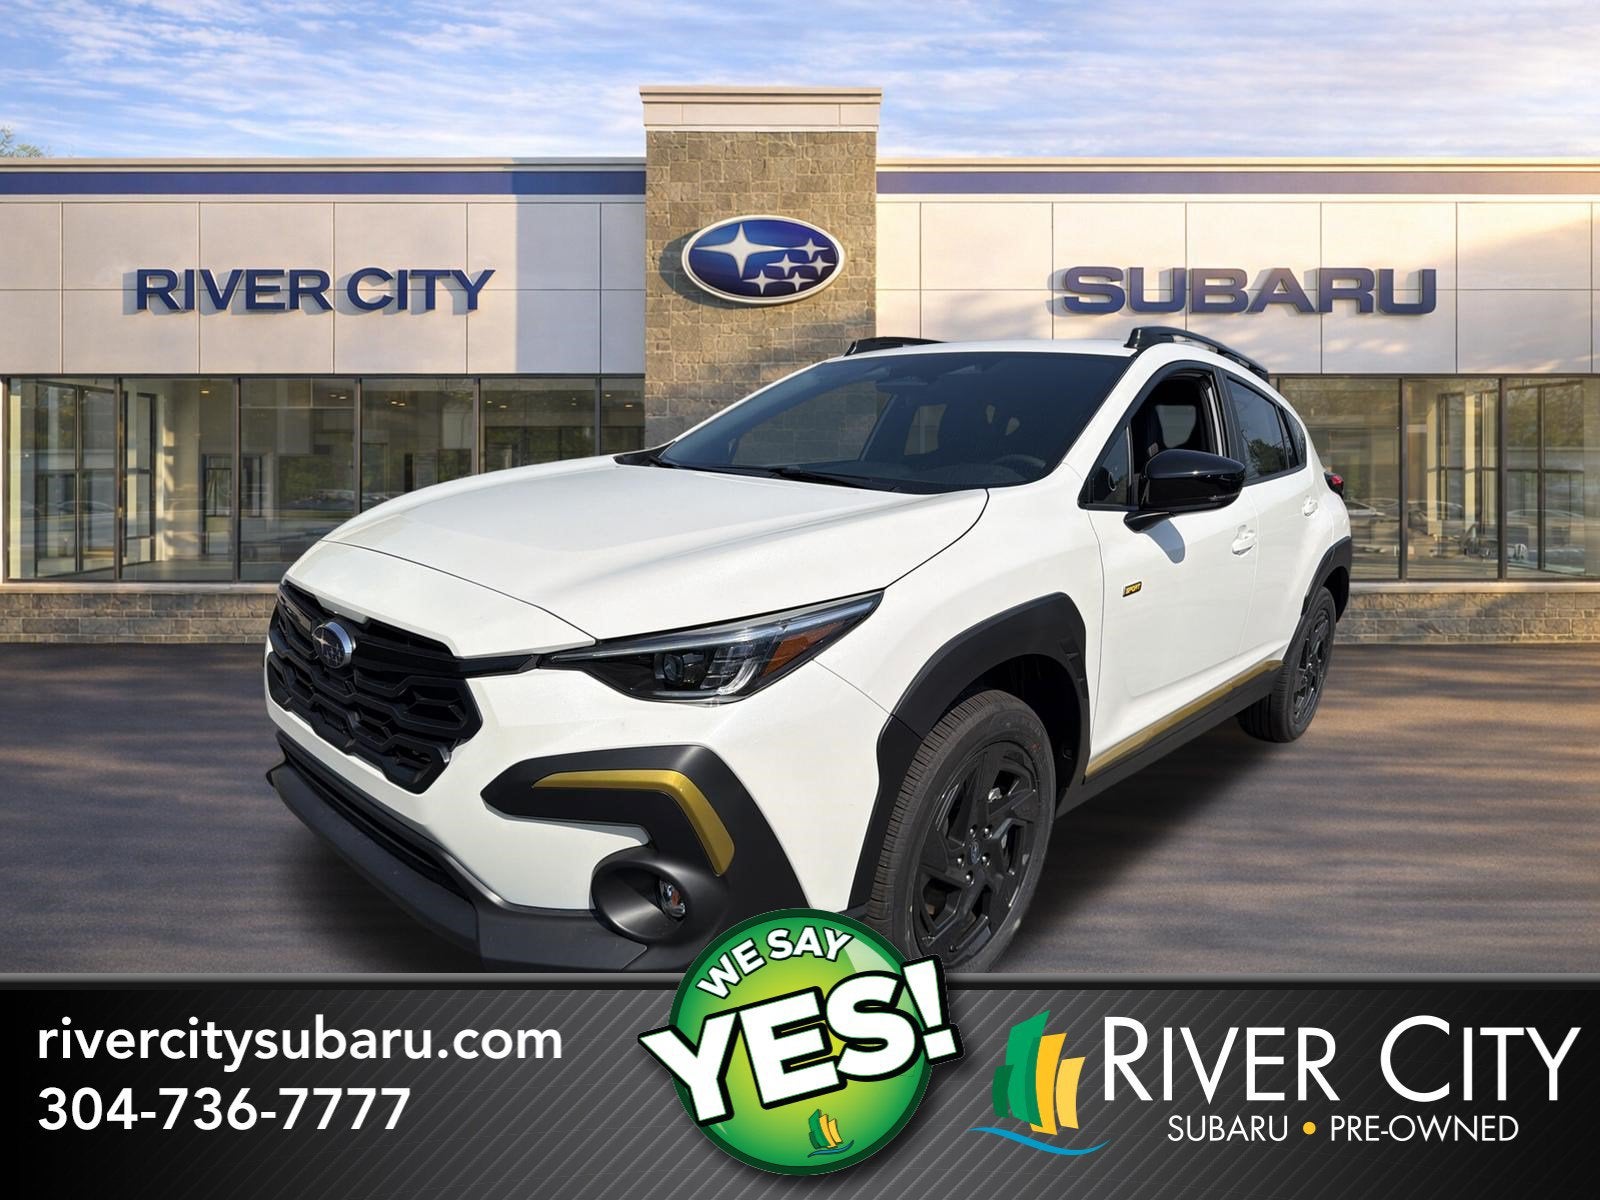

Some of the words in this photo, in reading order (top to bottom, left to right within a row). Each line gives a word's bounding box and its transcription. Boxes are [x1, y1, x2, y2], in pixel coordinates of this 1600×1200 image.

[136, 268, 335, 312] RIVER
[346, 266, 497, 312] CITY
[1063, 265, 1438, 315] SUBARU
